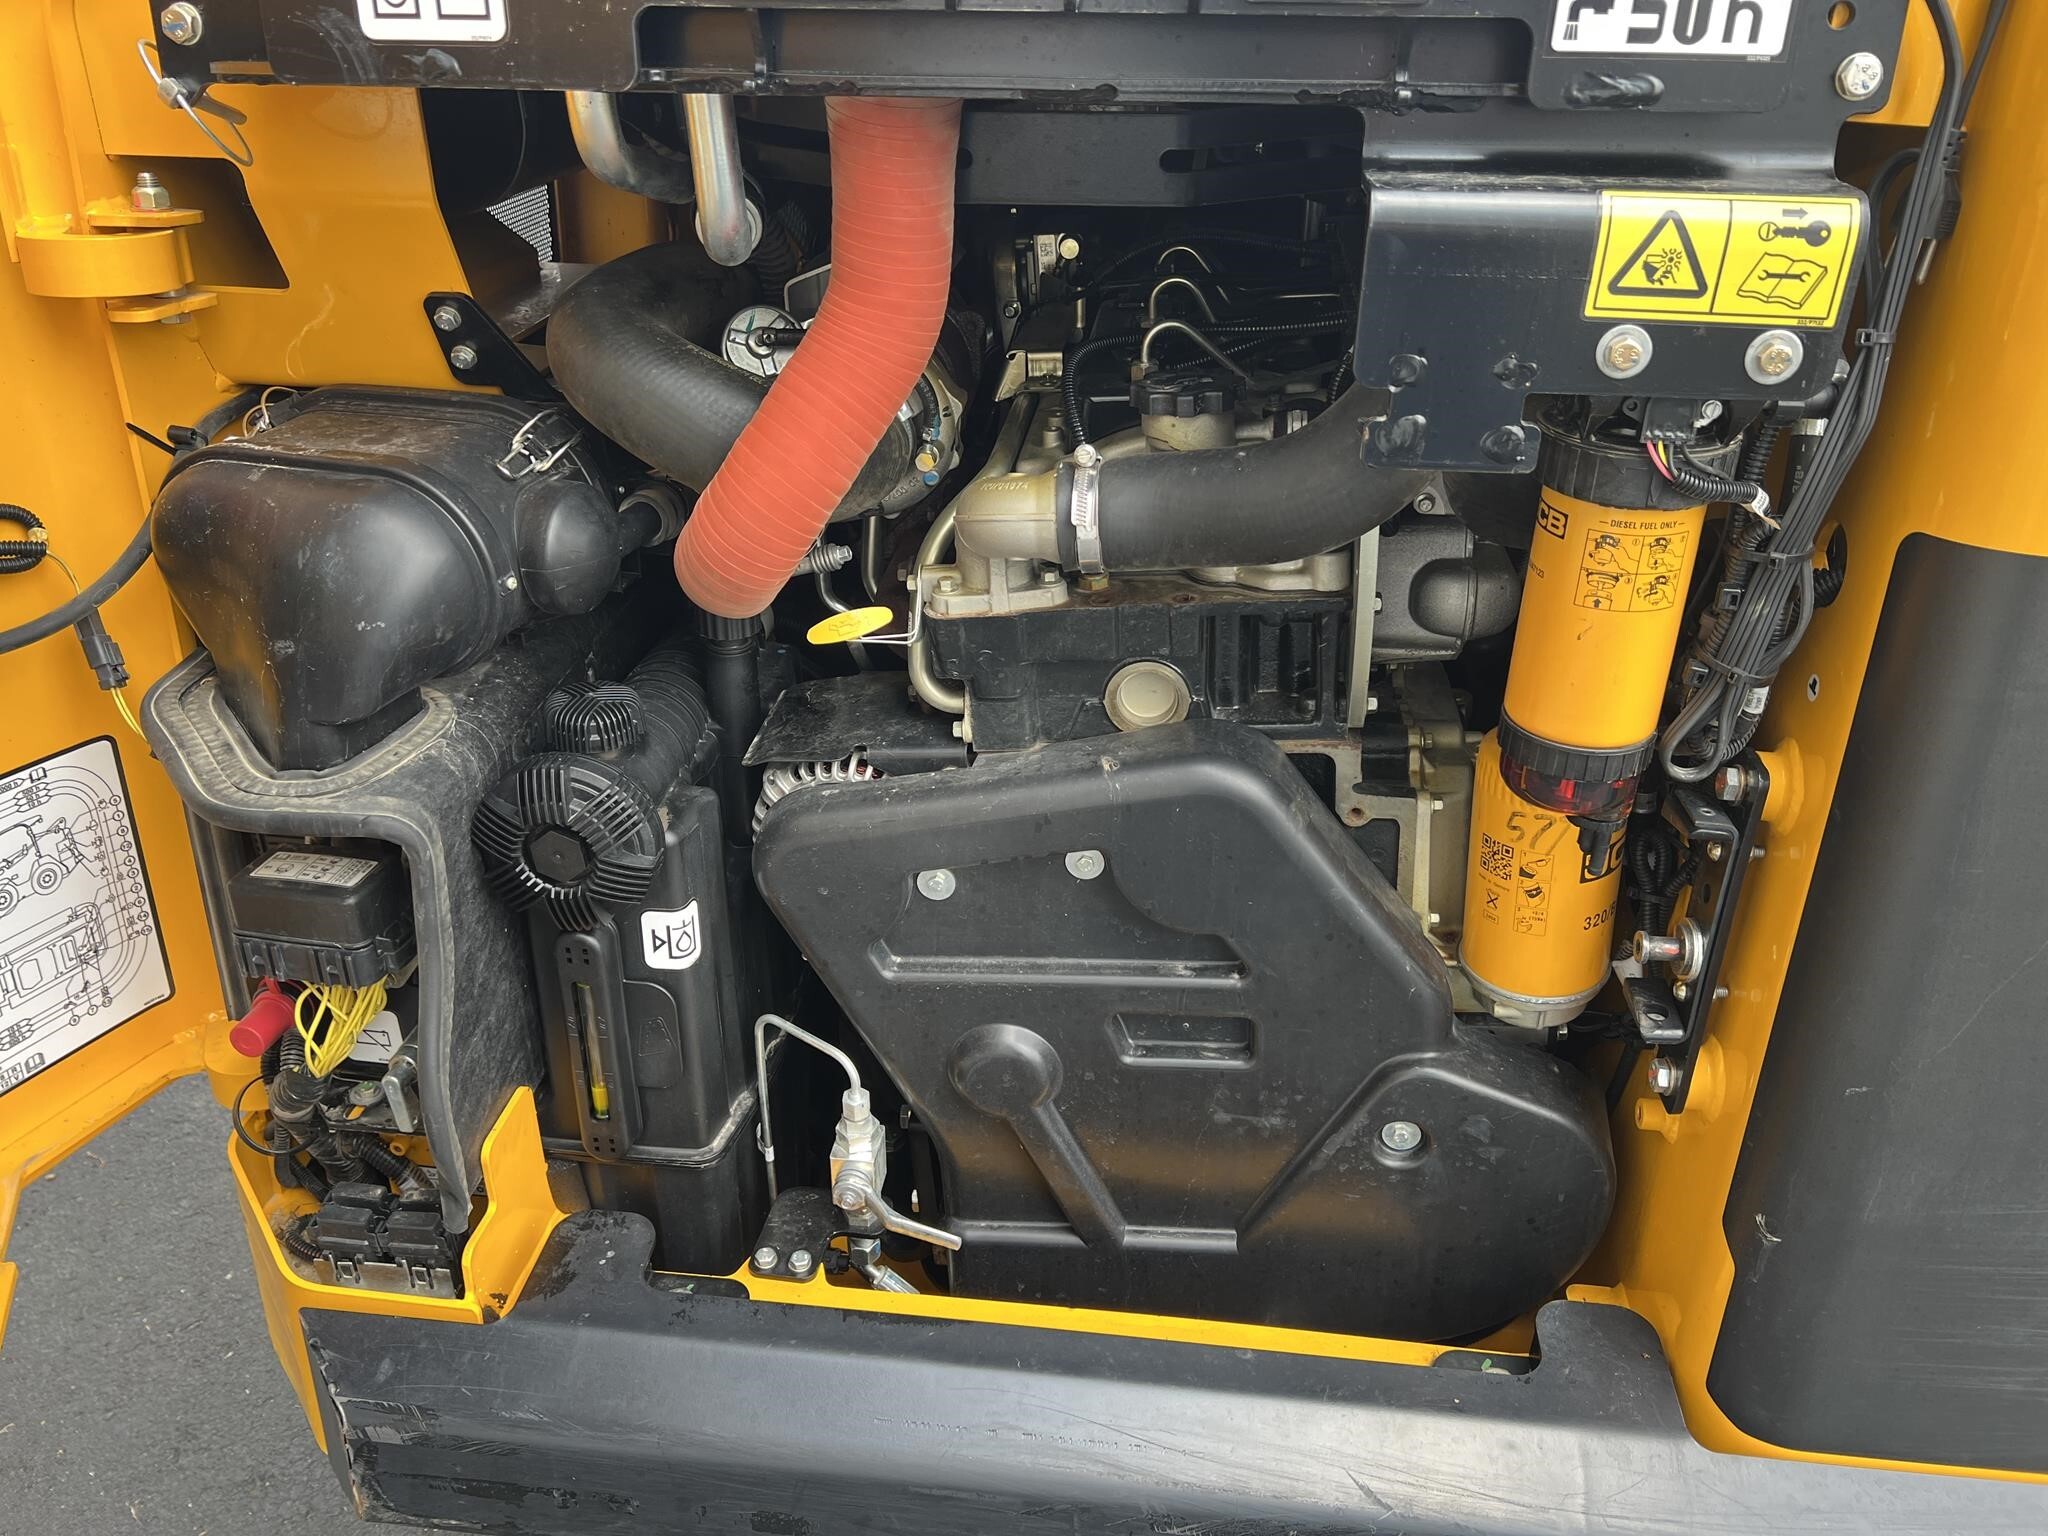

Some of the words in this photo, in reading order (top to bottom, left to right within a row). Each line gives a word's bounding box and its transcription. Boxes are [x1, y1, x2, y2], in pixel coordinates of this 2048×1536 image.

[1610, 519, 1637, 530] DIESEL
[1640, 521, 1658, 530] FUEL
[1660, 520, 1678, 530] ONLY
